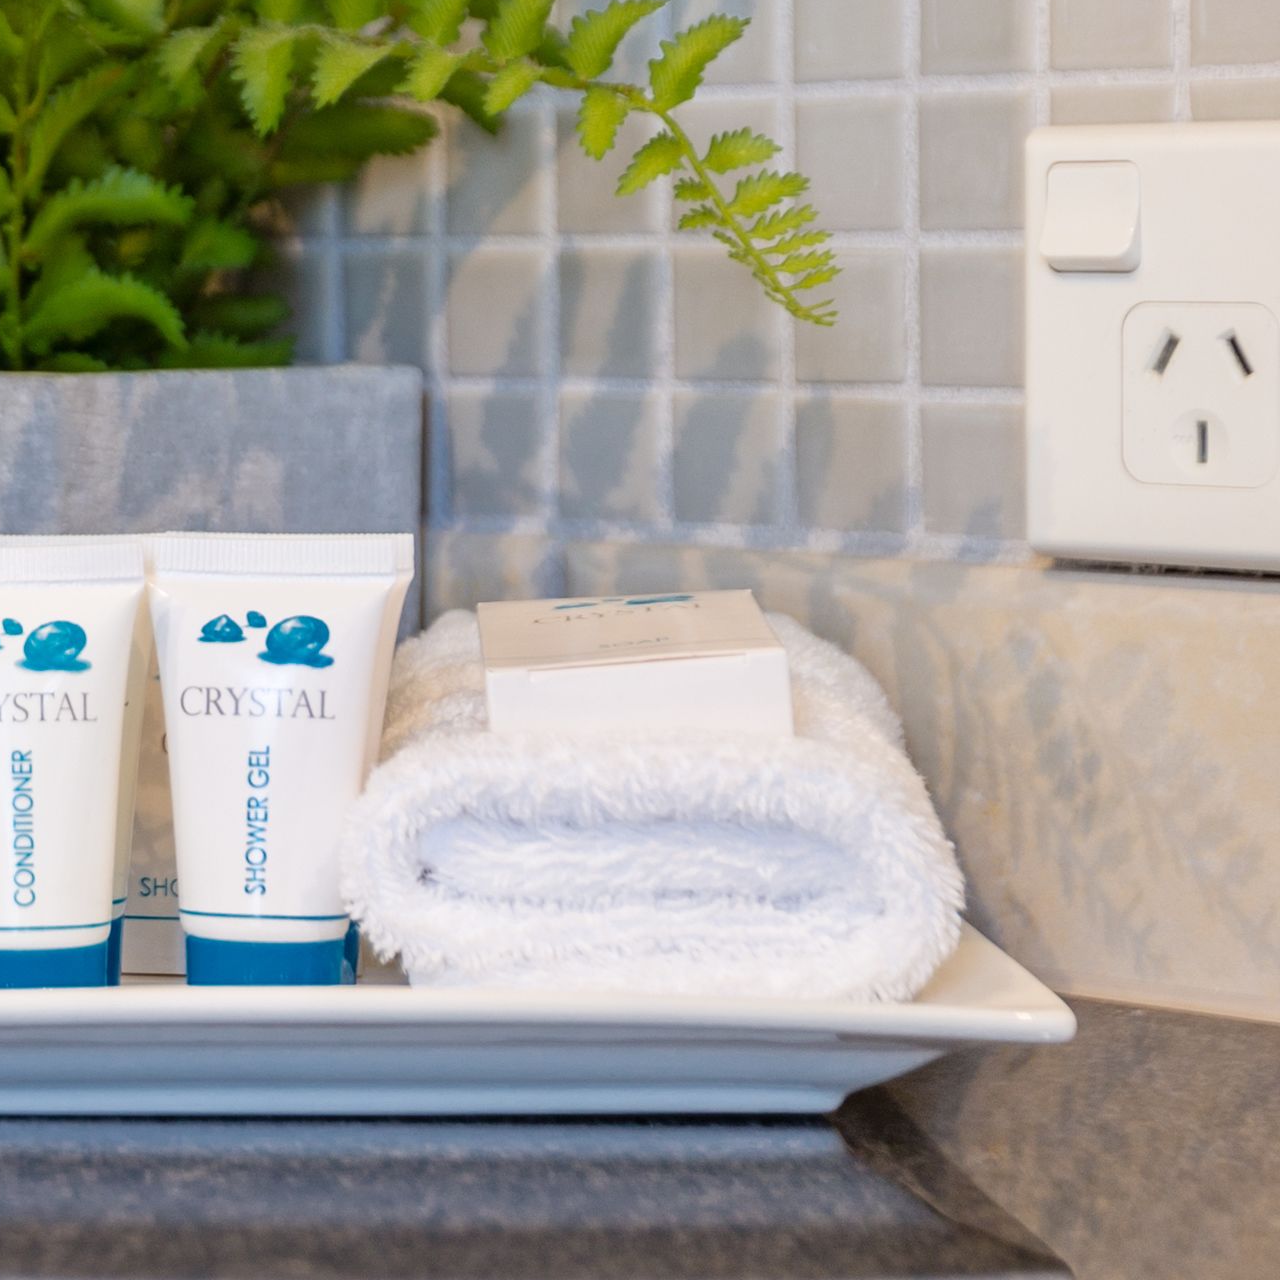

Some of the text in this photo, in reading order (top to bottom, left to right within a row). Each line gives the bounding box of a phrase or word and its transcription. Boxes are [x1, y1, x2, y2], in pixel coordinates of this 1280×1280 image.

[180, 685, 336, 720] CRYSTAL
[11, 749, 36, 908] CONDITIONER
[244, 745, 270, 896] SHOWER GEL
